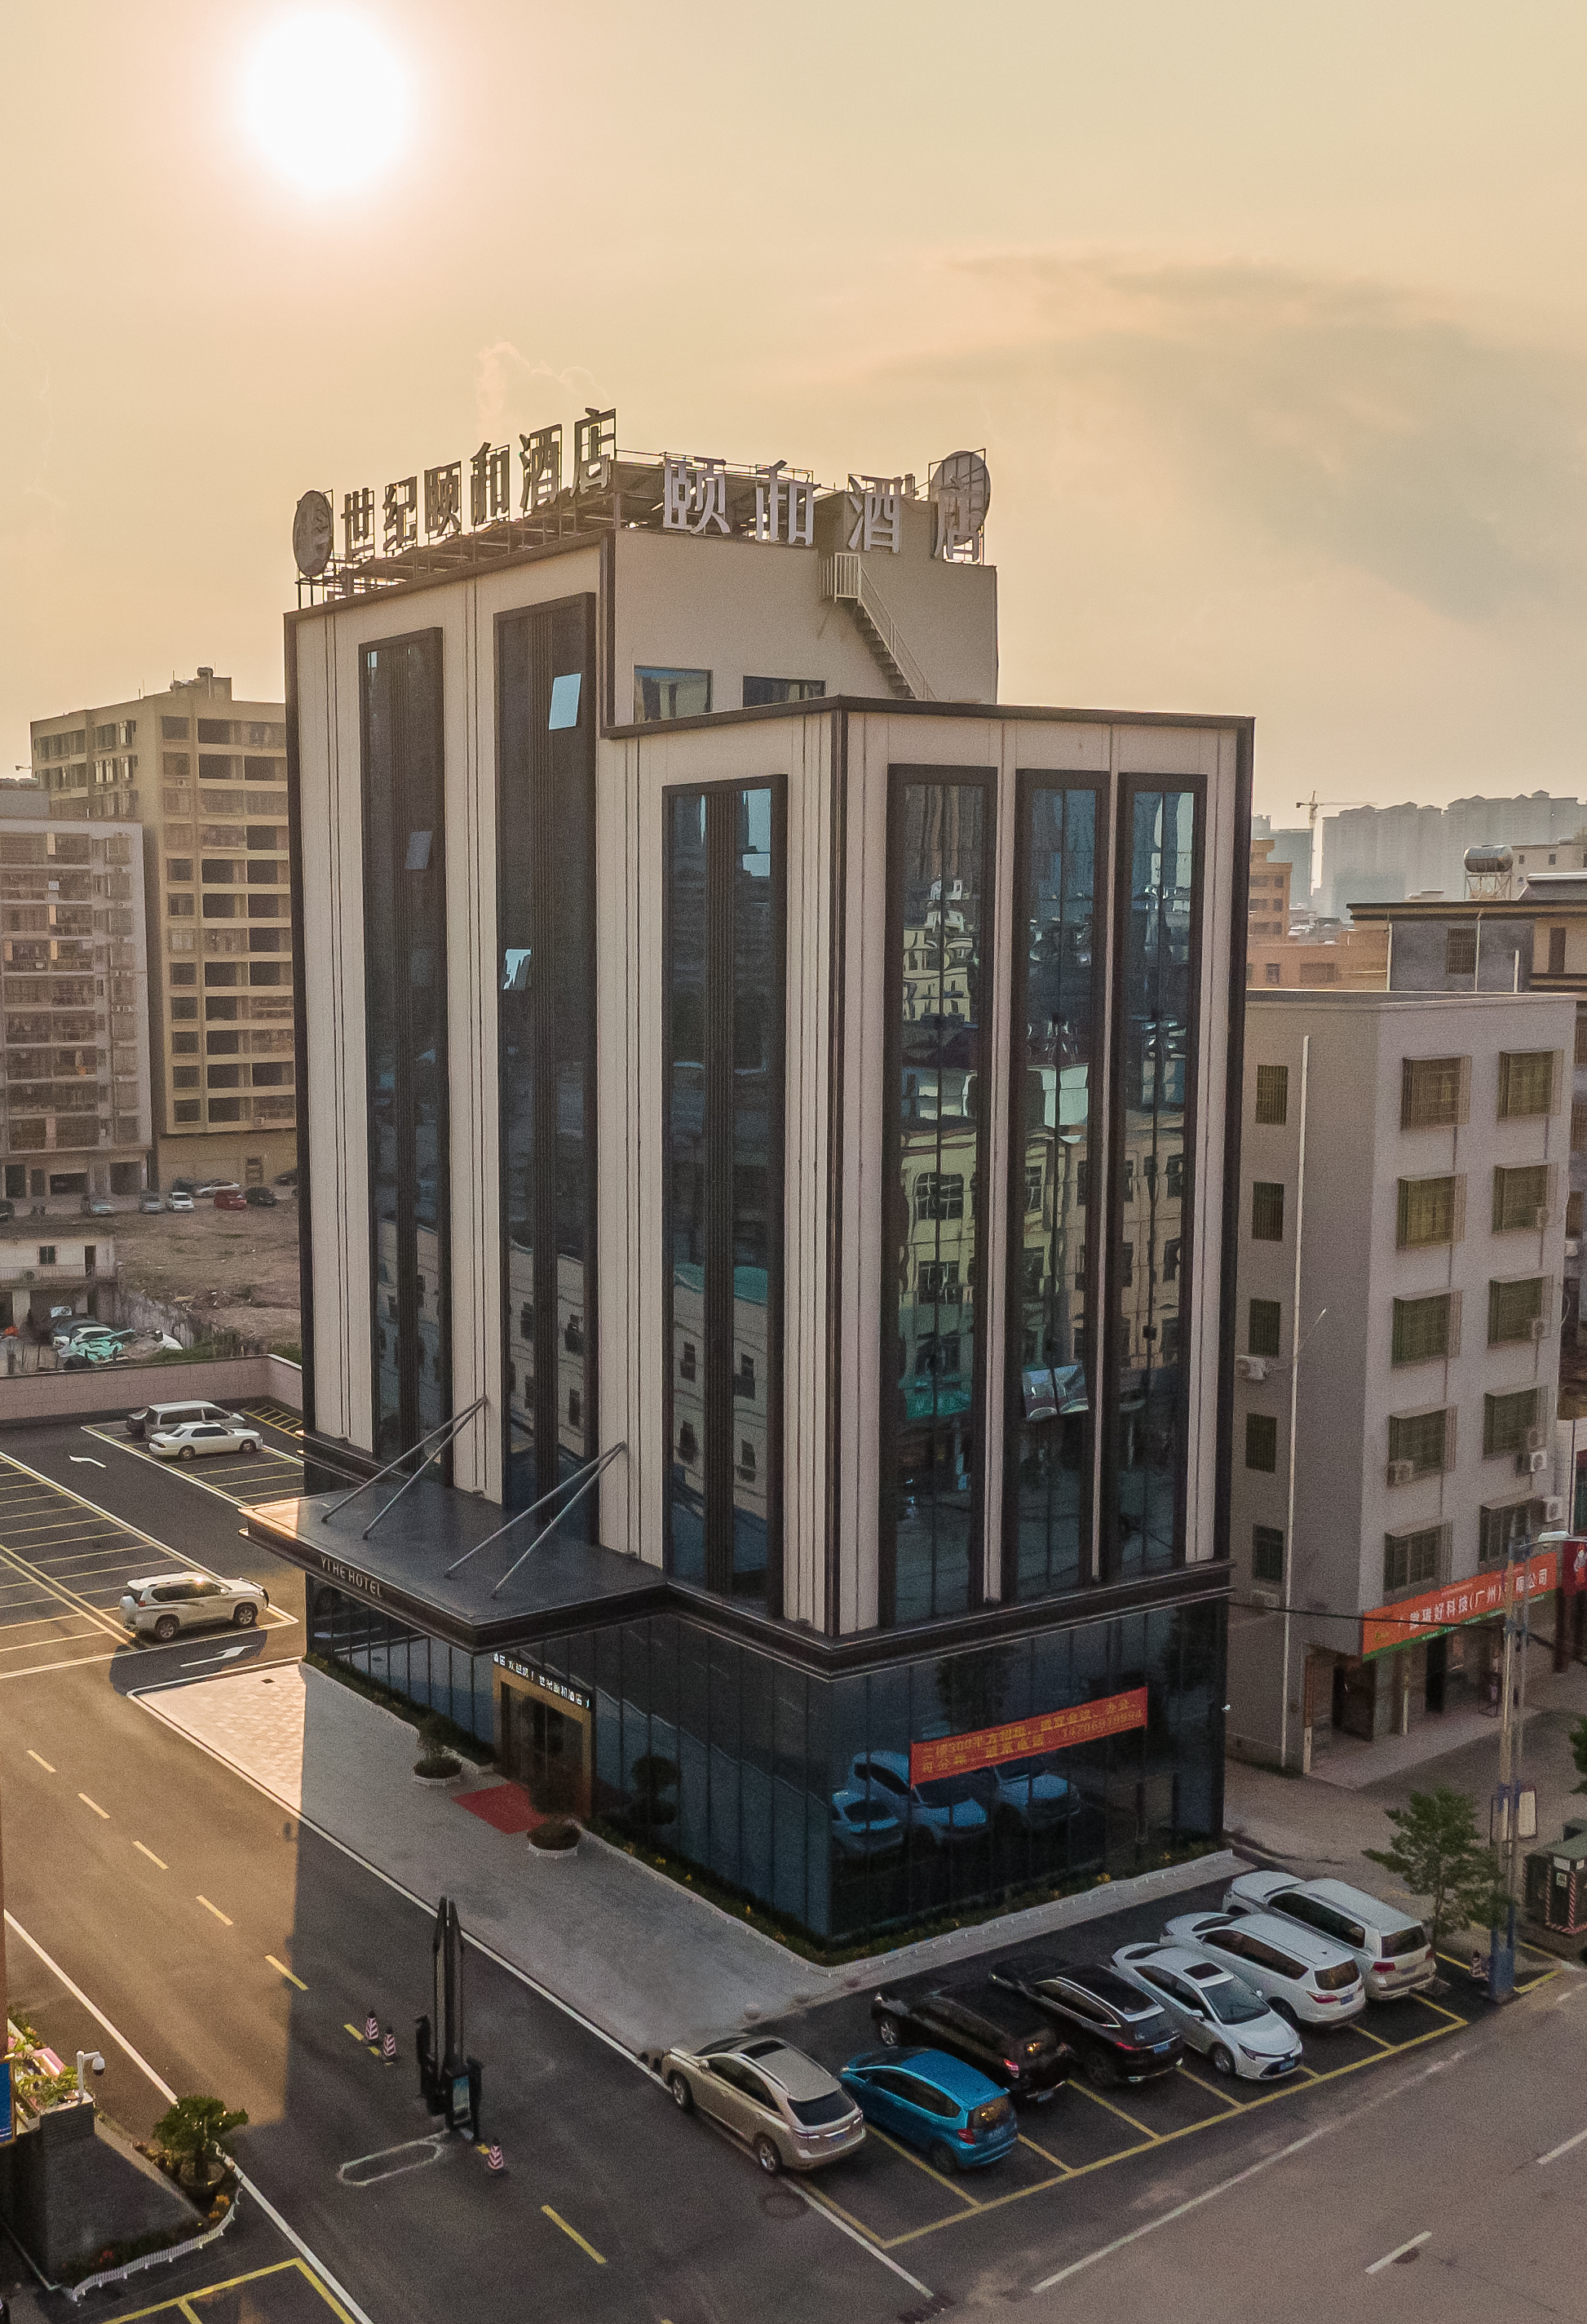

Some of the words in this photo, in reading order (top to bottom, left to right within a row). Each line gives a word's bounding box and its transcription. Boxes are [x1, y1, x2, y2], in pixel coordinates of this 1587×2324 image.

[341, 408, 617, 563] 世纪颐和酒店
[662, 457, 983, 561] 颐和酒店
[348, 1568, 382, 1598] HOTEL
